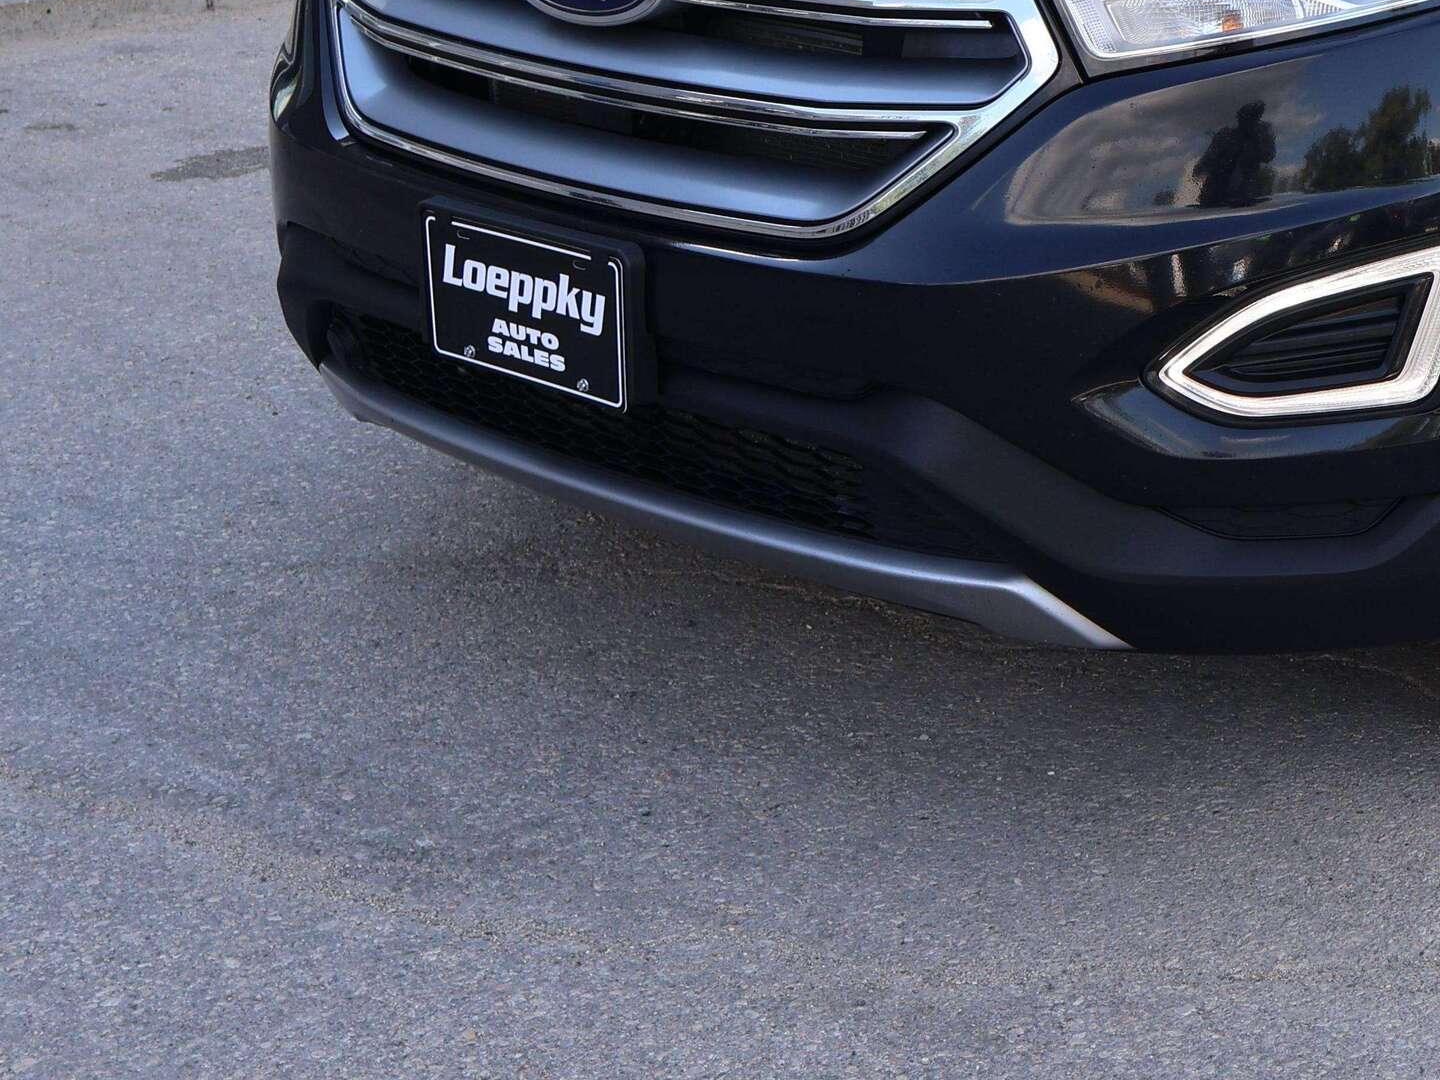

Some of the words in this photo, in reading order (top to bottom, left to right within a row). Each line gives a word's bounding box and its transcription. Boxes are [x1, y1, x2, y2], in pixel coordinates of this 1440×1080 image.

[442, 243, 606, 336] Loeppky
[491, 318, 559, 350] AUTO
[487, 336, 566, 372] SALES
